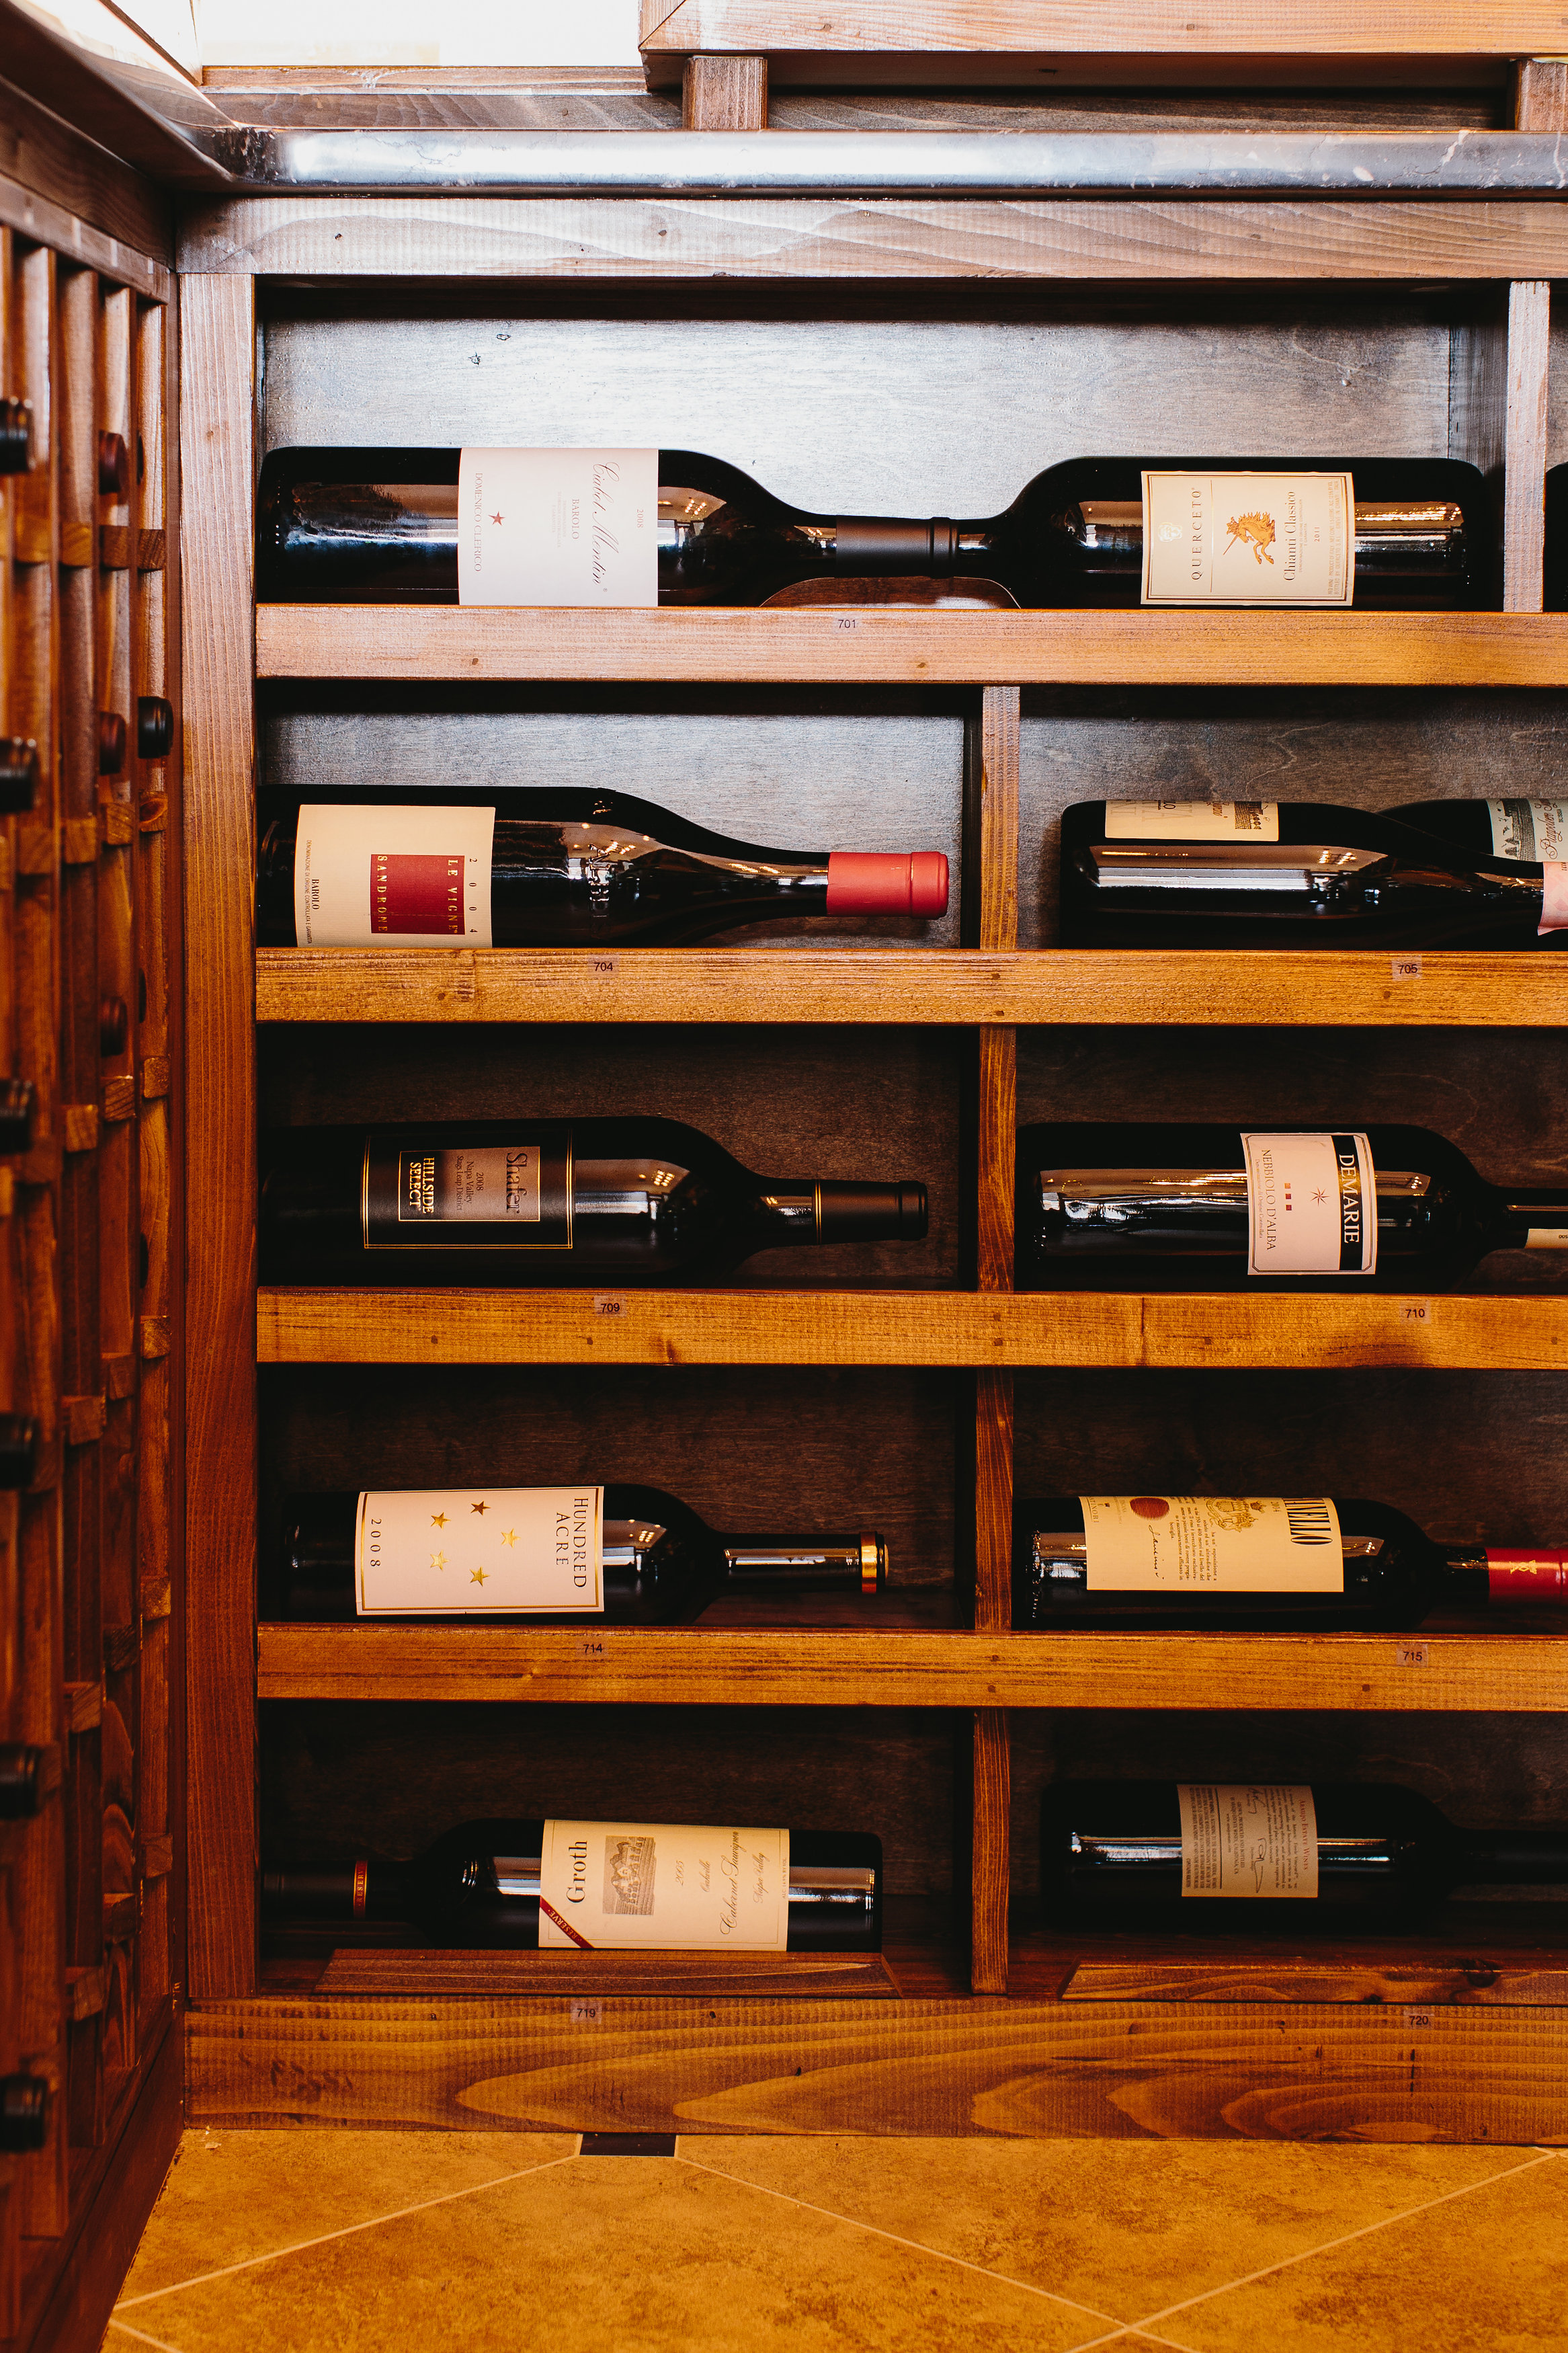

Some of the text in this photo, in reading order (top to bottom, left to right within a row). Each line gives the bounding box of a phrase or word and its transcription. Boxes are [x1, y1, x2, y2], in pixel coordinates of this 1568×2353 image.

[474, 473, 483, 571] DOMENICO CLERICO
[571, 499, 579, 539] BAROLO
[592, 462, 620, 586] Ciabot Mentin
[1191, 491, 1203, 580] QUERCETO
[1283, 491, 1296, 581] Chianti Classico
[837, 619, 856, 629] 701
[376, 855, 388, 932] SANDRONE
[447, 859, 458, 930] LE VIGNE
[468, 858, 478, 933] 2004
[593, 962, 614, 971] 704
[1398, 964, 1418, 974] 705
[409, 1162, 421, 1207] SELECT
[422, 1158, 434, 1213] HILLSIDE
[455, 1156, 463, 1170] Stags
[455, 1171, 463, 1186] Leap
[464, 1162, 474, 1203] Napa Valley
[476, 1172, 484, 1191] 2008
[506, 1152, 528, 1213] Shafer
[1262, 1150, 1276, 1250] NEBBIOLO D'ALBA
[1339, 1154, 1360, 1244] DEMARIE
[600, 1302, 620, 1313] 709
[1405, 1308, 1425, 1318] 710
[370, 1518, 382, 1567] 2008
[556, 1512, 571, 1565] ACRE
[573, 1498, 589, 1588] HUNDRED
[583, 1643, 603, 1653] 714
[1403, 1651, 1423, 1661] 715
[565, 1839, 588, 1904] Groth
[675, 1860, 684, 1886] 2005
[699, 1859, 710, 1892] Oakville
[720, 1831, 747, 1934] Cabernet Sauvignon
[752, 1853, 770, 1903] Napa Valley
[549, 1911, 579, 1940] RESERVE
[577, 2008, 595, 2018] 719
[1409, 2016, 1429, 2026] 720
